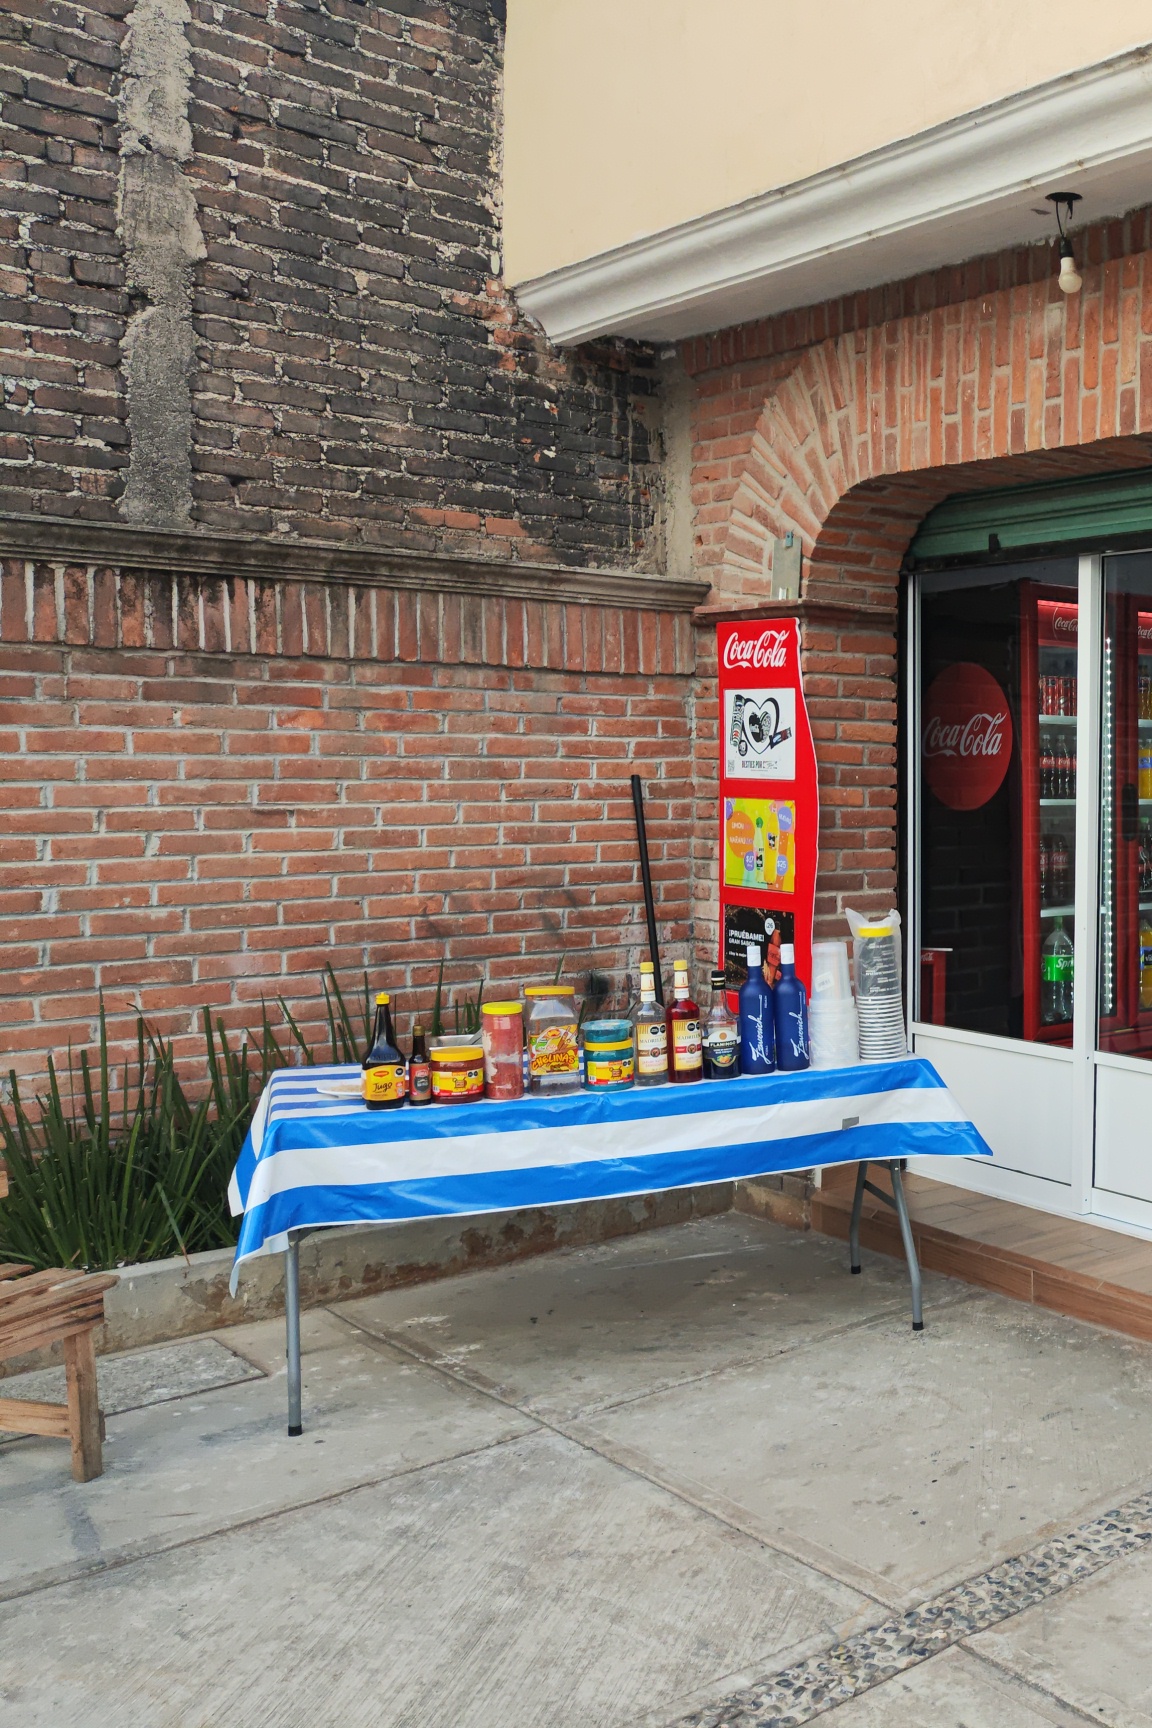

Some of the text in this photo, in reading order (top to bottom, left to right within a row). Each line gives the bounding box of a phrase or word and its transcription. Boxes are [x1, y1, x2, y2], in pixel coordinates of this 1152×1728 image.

[1054, 617, 1078, 632] Coca-Co
[723, 630, 790, 669] Coca-Cola
[923, 713, 1007, 757] Coca-Cola
[1056, 957, 1074, 970] Spri
[532, 1052, 575, 1070] CHELINAS
[373, 1081, 392, 1092] Jugo
